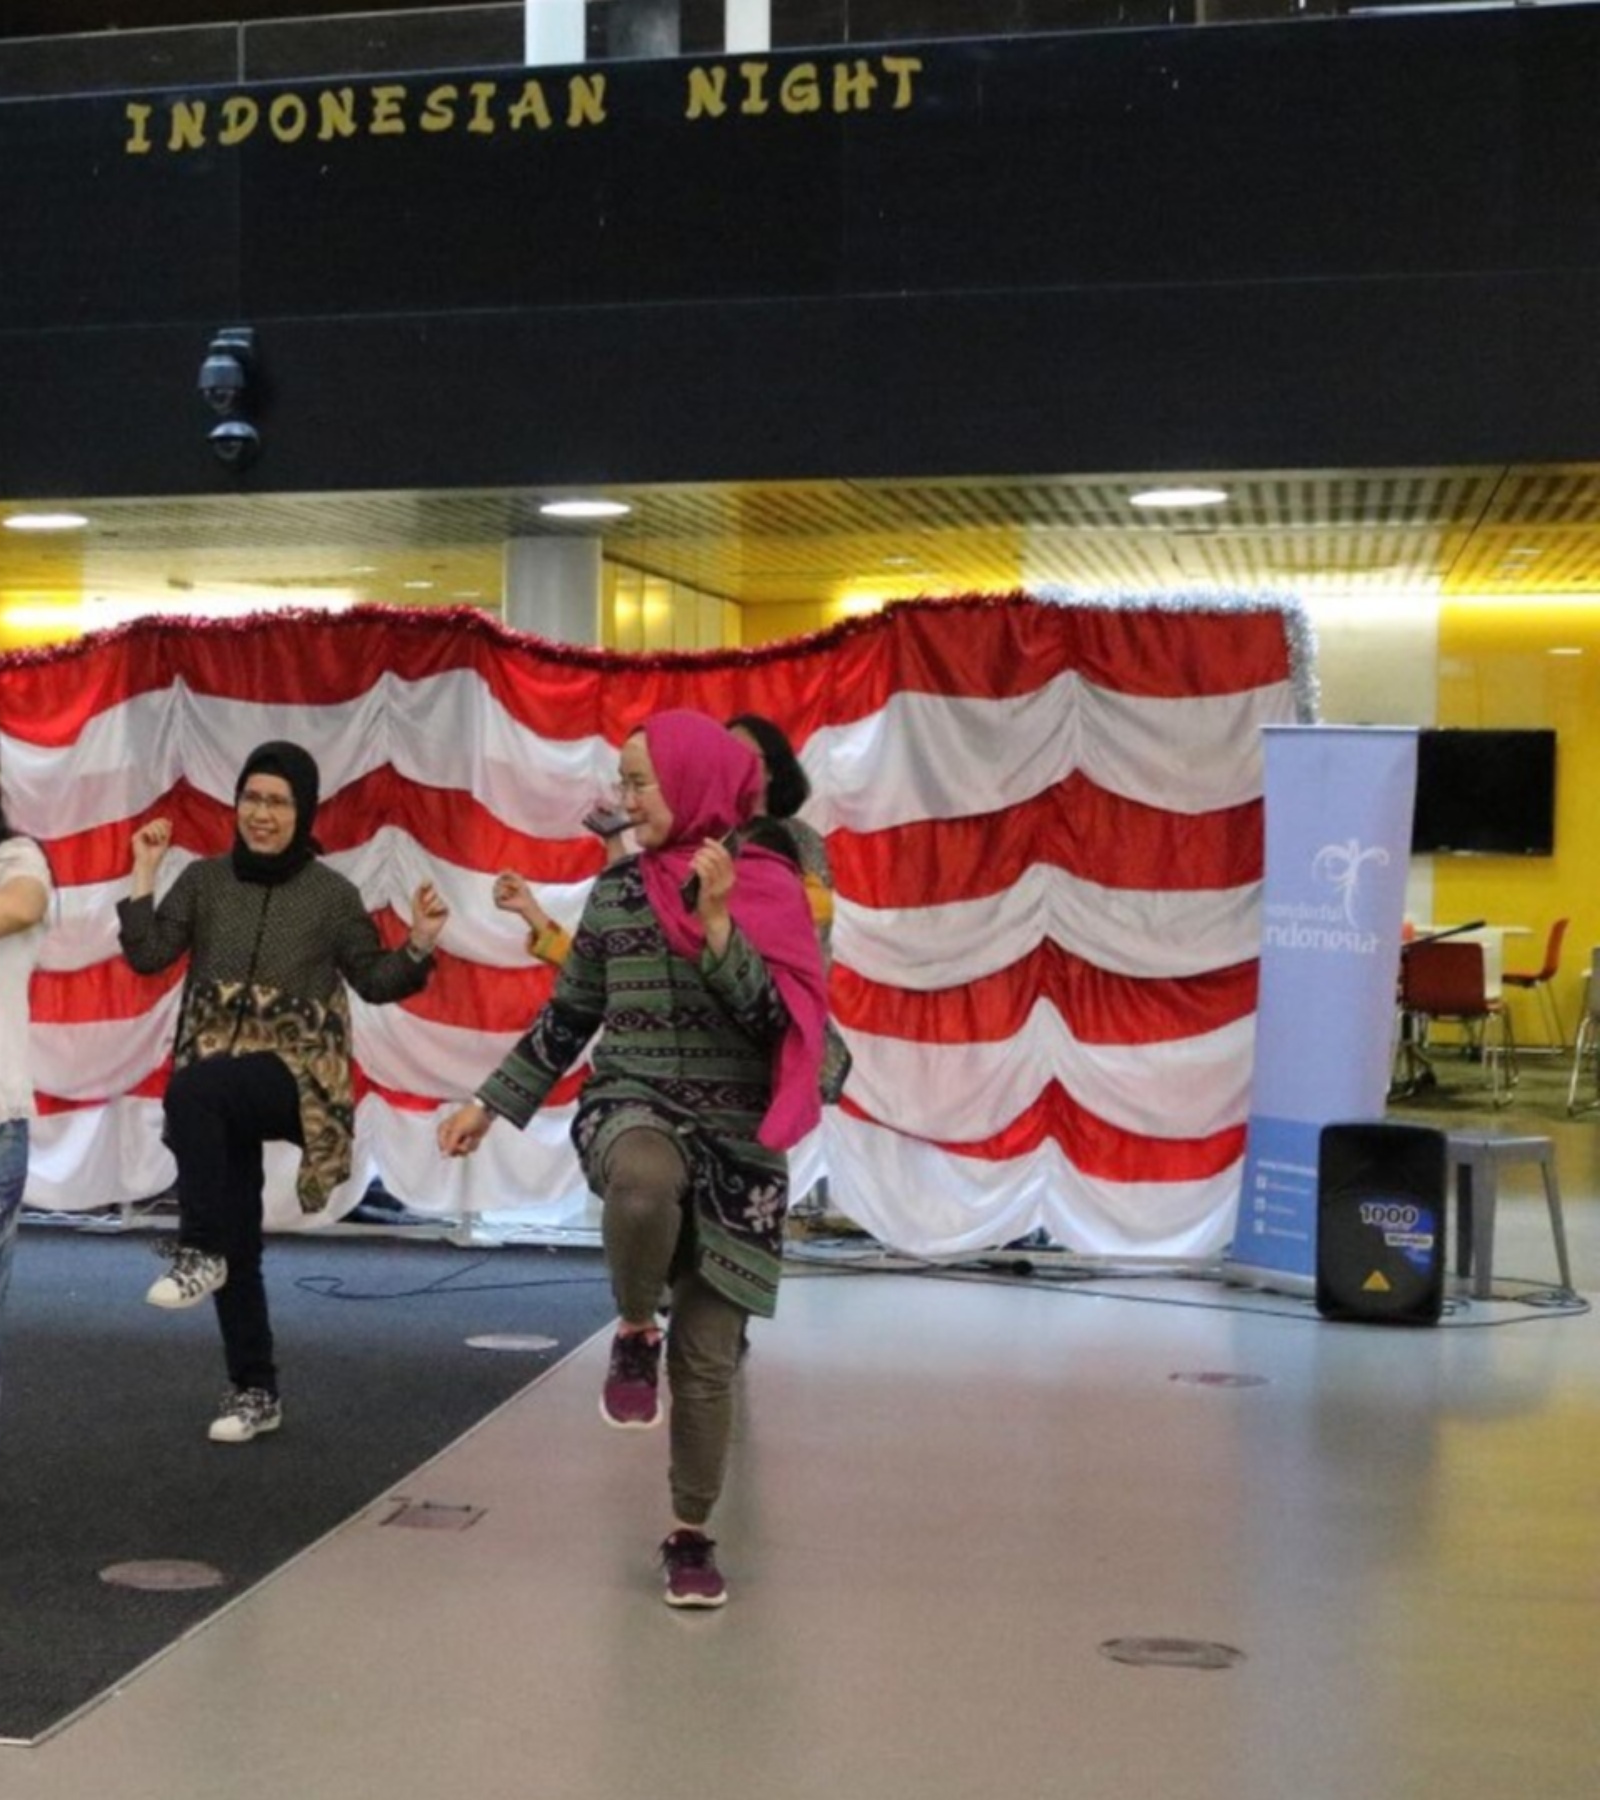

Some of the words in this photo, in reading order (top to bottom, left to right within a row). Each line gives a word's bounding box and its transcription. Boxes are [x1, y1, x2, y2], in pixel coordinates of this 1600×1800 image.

[125, 74, 607, 154] INDONESIAN
[685, 55, 922, 119] NIGHT
[1263, 921, 1380, 954] ndonesia
[1360, 1203, 1418, 1226] 1000
